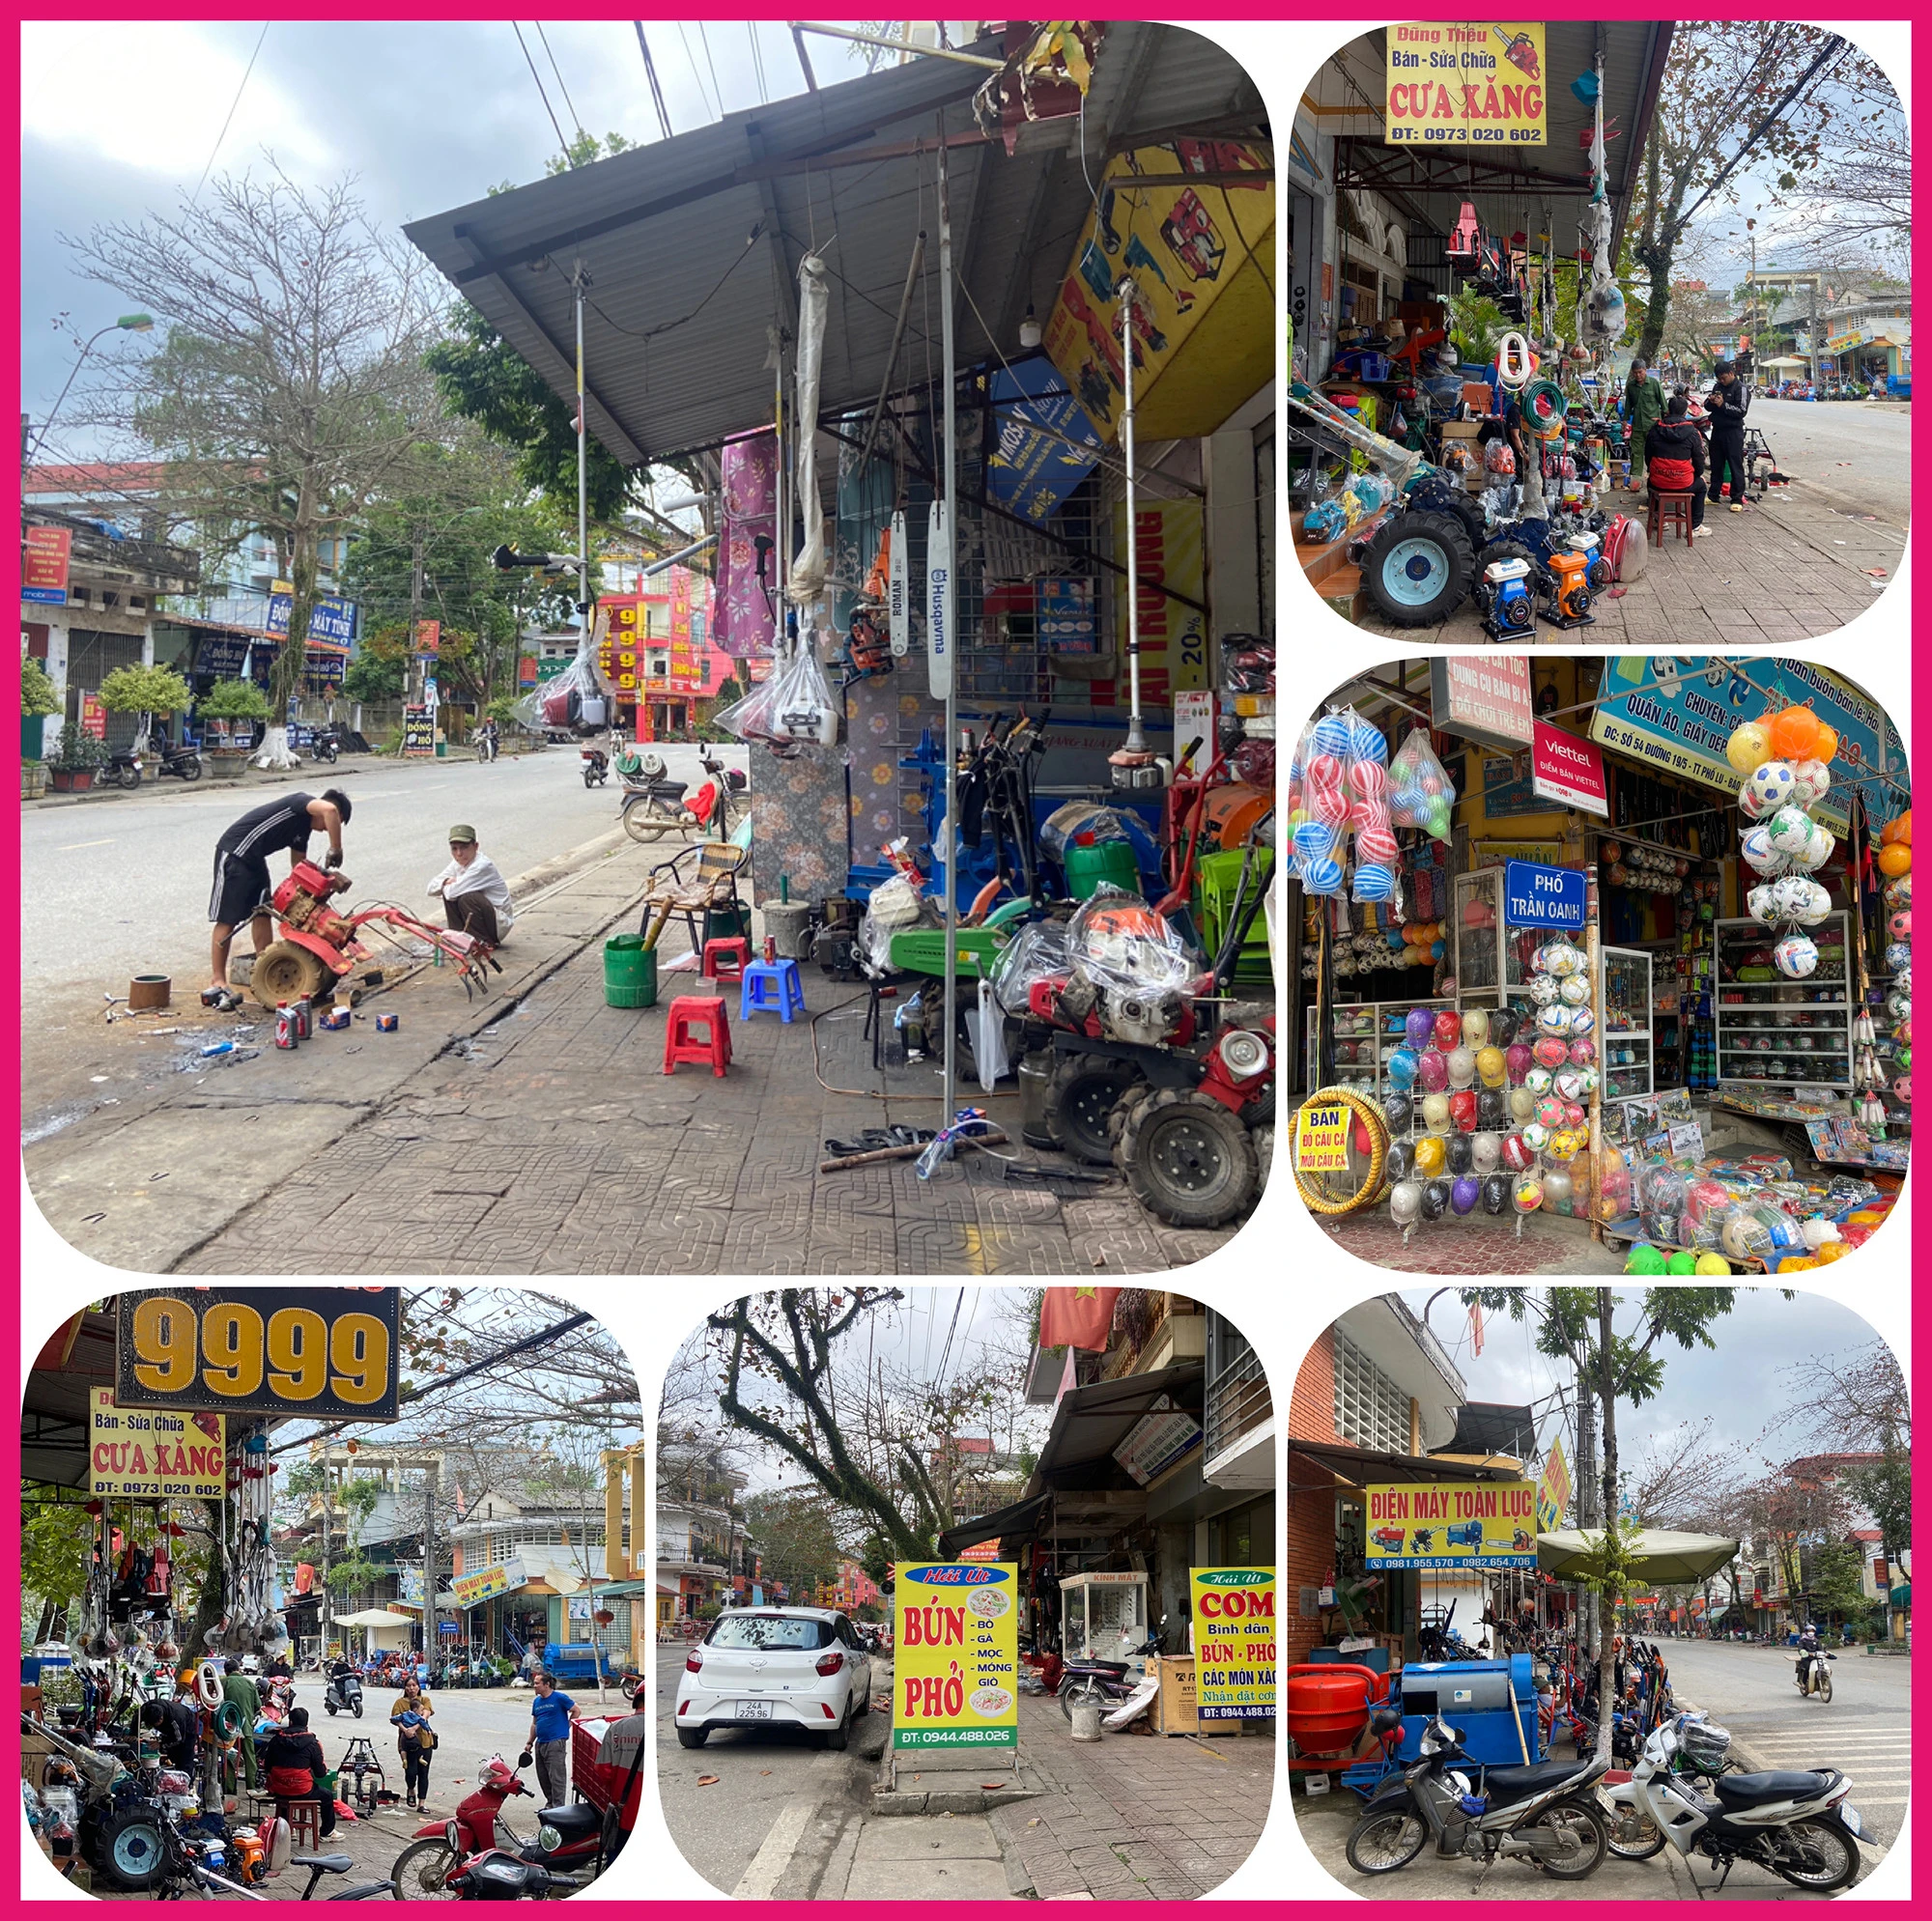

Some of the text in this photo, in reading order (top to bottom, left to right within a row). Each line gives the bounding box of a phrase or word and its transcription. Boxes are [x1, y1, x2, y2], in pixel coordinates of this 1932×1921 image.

[1446, 27, 1487, 42] Thêu
[1392, 50, 1419, 68] Bán
[1430, 50, 1456, 68] Sửa
[1461, 50, 1496, 69] Chữa
[1389, 74, 1543, 120] CƯA XĂNG
[1391, 127, 1542, 141] ĐT: 0973 020 602
[893, 579, 901, 616] ROMAN
[1453, 663, 1478, 689] DỤNG
[1479, 672, 1492, 697] CỤ
[1512, 684, 1521, 704] BI
[1522, 688, 1528, 706] A
[1808, 666, 1835, 699] buôn
[1835, 687, 1854, 713] bán
[1473, 701, 1496, 724] CHƠI
[1518, 716, 1530, 734] EM
[1685, 692, 1728, 726] CHUYÊN:
[1661, 707, 1681, 737] ÁO,
[1604, 725, 1620, 742] ĐC:
[1621, 731, 1635, 748] SỐ
[1634, 737, 1644, 752] 54
[1644, 744, 1671, 764] ĐƯỜNG
[1672, 753, 1689, 770] 19/5
[1692, 762, 1701, 776] TT
[1701, 766, 1717, 781] PHỐ
[1717, 773, 1724, 784] LU
[1560, 769, 1574, 780] BÁN
[1575, 775, 1600, 790] VIETTEL
[1535, 871, 1564, 893] PHỐ
[1511, 891, 1580, 920] TRẦN OANH
[1310, 1109, 1339, 1127] BÁN
[1302, 1129, 1345, 1147] ĐỒ CÂU CÁ
[1317, 1151, 1333, 1168] CÂU
[133, 1296, 390, 1405] 9999
[95, 1412, 119, 1431] Bán
[128, 1412, 151, 1431] Sửa
[155, 1414, 185, 1432] Chữa
[93, 1437, 223, 1478] CƯA XĂNG
[95, 1482, 221, 1496] ĐT: 0973 020 602
[1371, 1484, 1532, 1526] ĐIỆN MÁY TOÀN LỤC
[1386, 1558, 1454, 1568] 0981.955.570
[1463, 1557, 1530, 1567] 0982.654.706
[1094, 1572, 1116, 1581] KÍNH
[1199, 1589, 1275, 1619] CƠM
[903, 1596, 966, 1647] BÚN
[978, 1619, 994, 1629] BÒ
[1208, 1623, 1269, 1635] Bình dân
[978, 1632, 994, 1643] GÀ
[1201, 1639, 1234, 1663] BÚN
[978, 1661, 1012, 1672] MÓNG
[1203, 1667, 1225, 1686] CÁC
[1229, 1667, 1254, 1685] MÓN
[904, 1660, 964, 1717] PHỞ
[979, 1676, 999, 1687] GIÒ
[1203, 1690, 1234, 1704] Nhận
[1236, 1690, 1255, 1705] đặt
[1204, 1708, 1219, 1718] ĐT:
[901, 1730, 1010, 1743] ĐT: 0944.488.026
